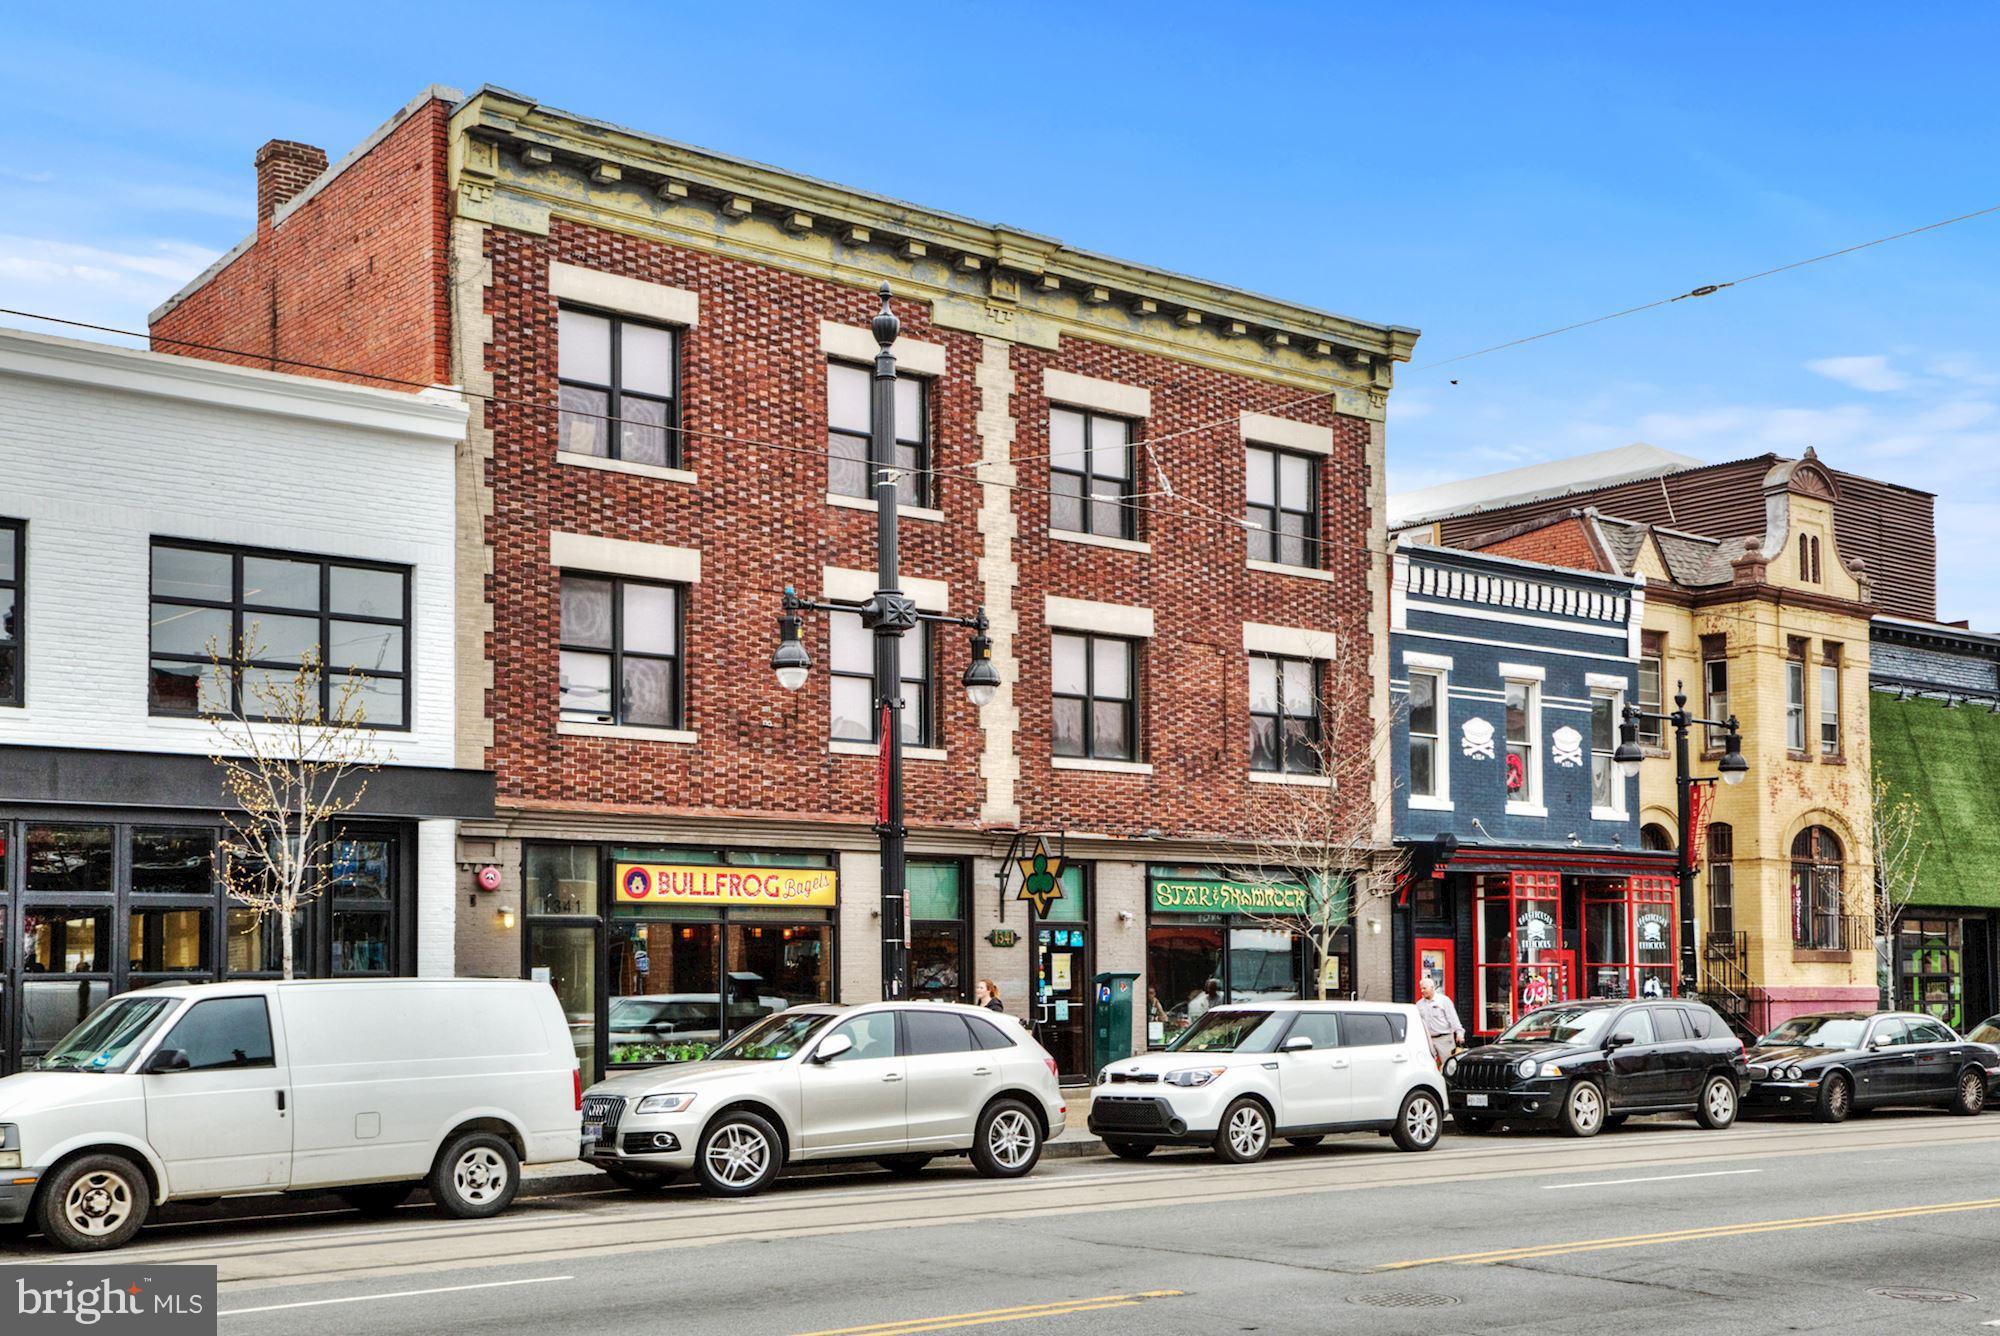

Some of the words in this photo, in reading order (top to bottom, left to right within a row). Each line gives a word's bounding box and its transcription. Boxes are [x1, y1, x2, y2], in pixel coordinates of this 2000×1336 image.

[658, 872, 780, 898] BULLFROG
[783, 873, 830, 899] Bagels
[1156, 882, 1213, 908] STAR
[544, 899, 580, 914] 1341
